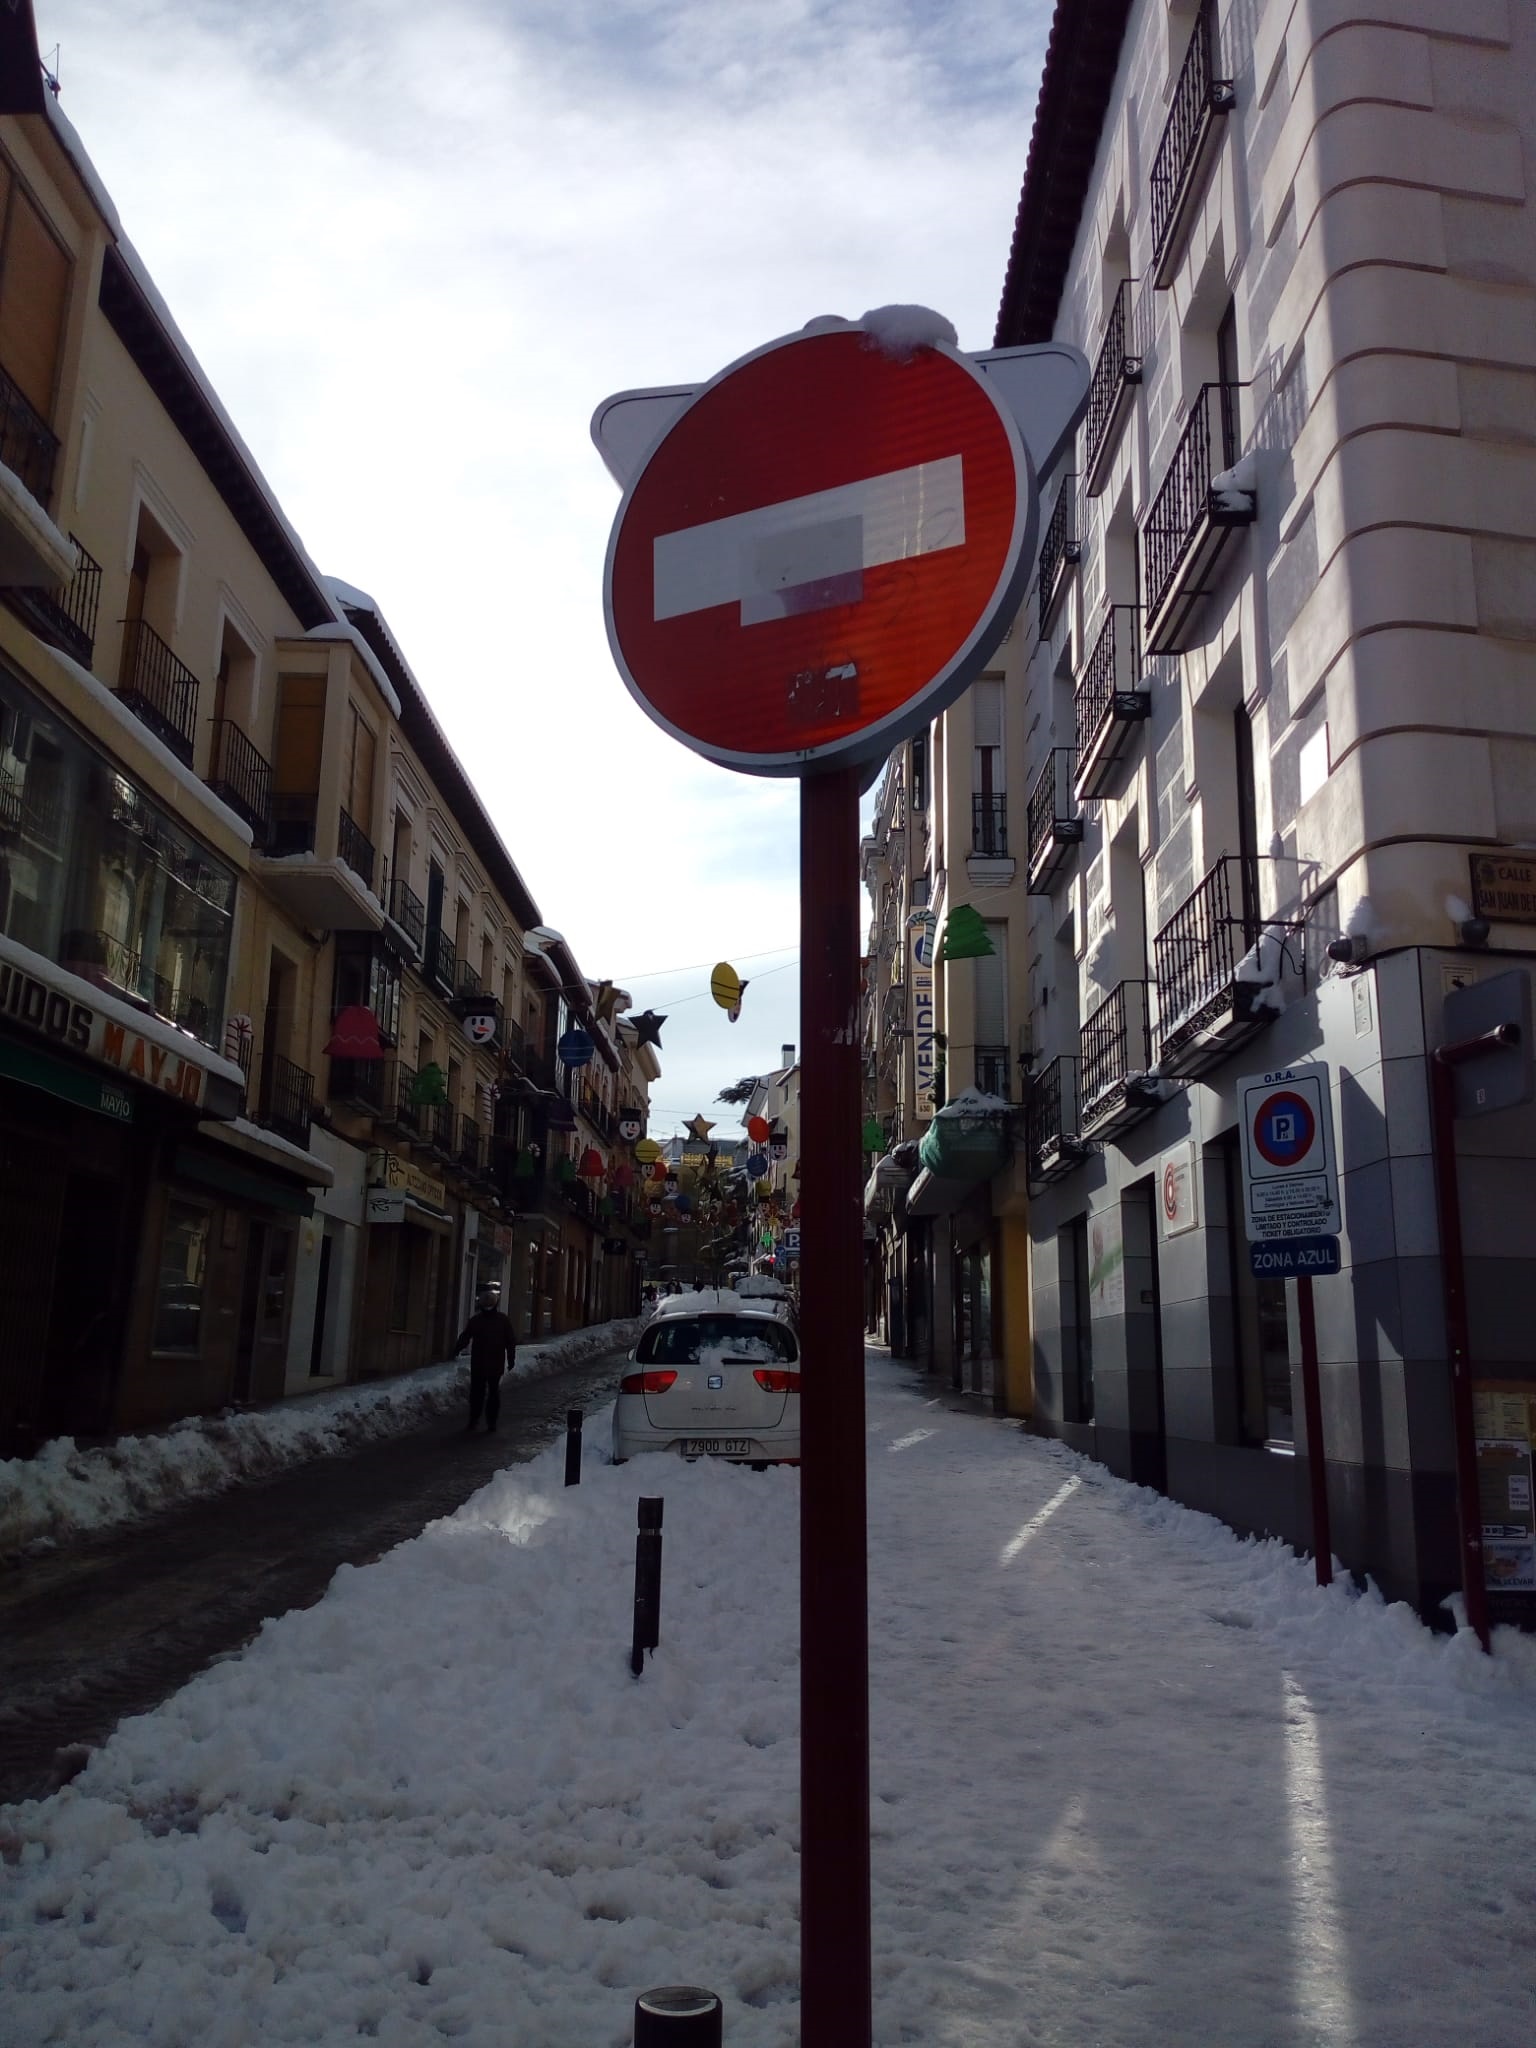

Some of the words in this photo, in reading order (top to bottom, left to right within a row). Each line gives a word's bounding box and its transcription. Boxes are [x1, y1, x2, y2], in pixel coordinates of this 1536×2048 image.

[1498, 867, 1532, 882] CALLE
[1480, 889, 1496, 908] SAN
[1497, 890, 1519, 912] JUAN
[1520, 893, 1531, 912] DE
[104, 1022, 203, 1105] MAYJO
[1264, 1071, 1296, 1084] O.R.A.
[101, 1093, 130, 1117] MAYJO
[1275, 1117, 1290, 1141] P
[1251, 1215, 1266, 1223] ZONA
[1268, 1214, 1275, 1222] DE
[1255, 1222, 1281, 1230] LIMITADO
[1287, 1218, 1327, 1228] CONTROLADO
[1282, 1226, 1321, 1236] OBLIGATORIO
[1253, 1253, 1293, 1269] ZONA
[1297, 1248, 1335, 1266] AZUL
[691, 1440, 719, 1452] 7900
[725, 1440, 747, 1452] GTZ
